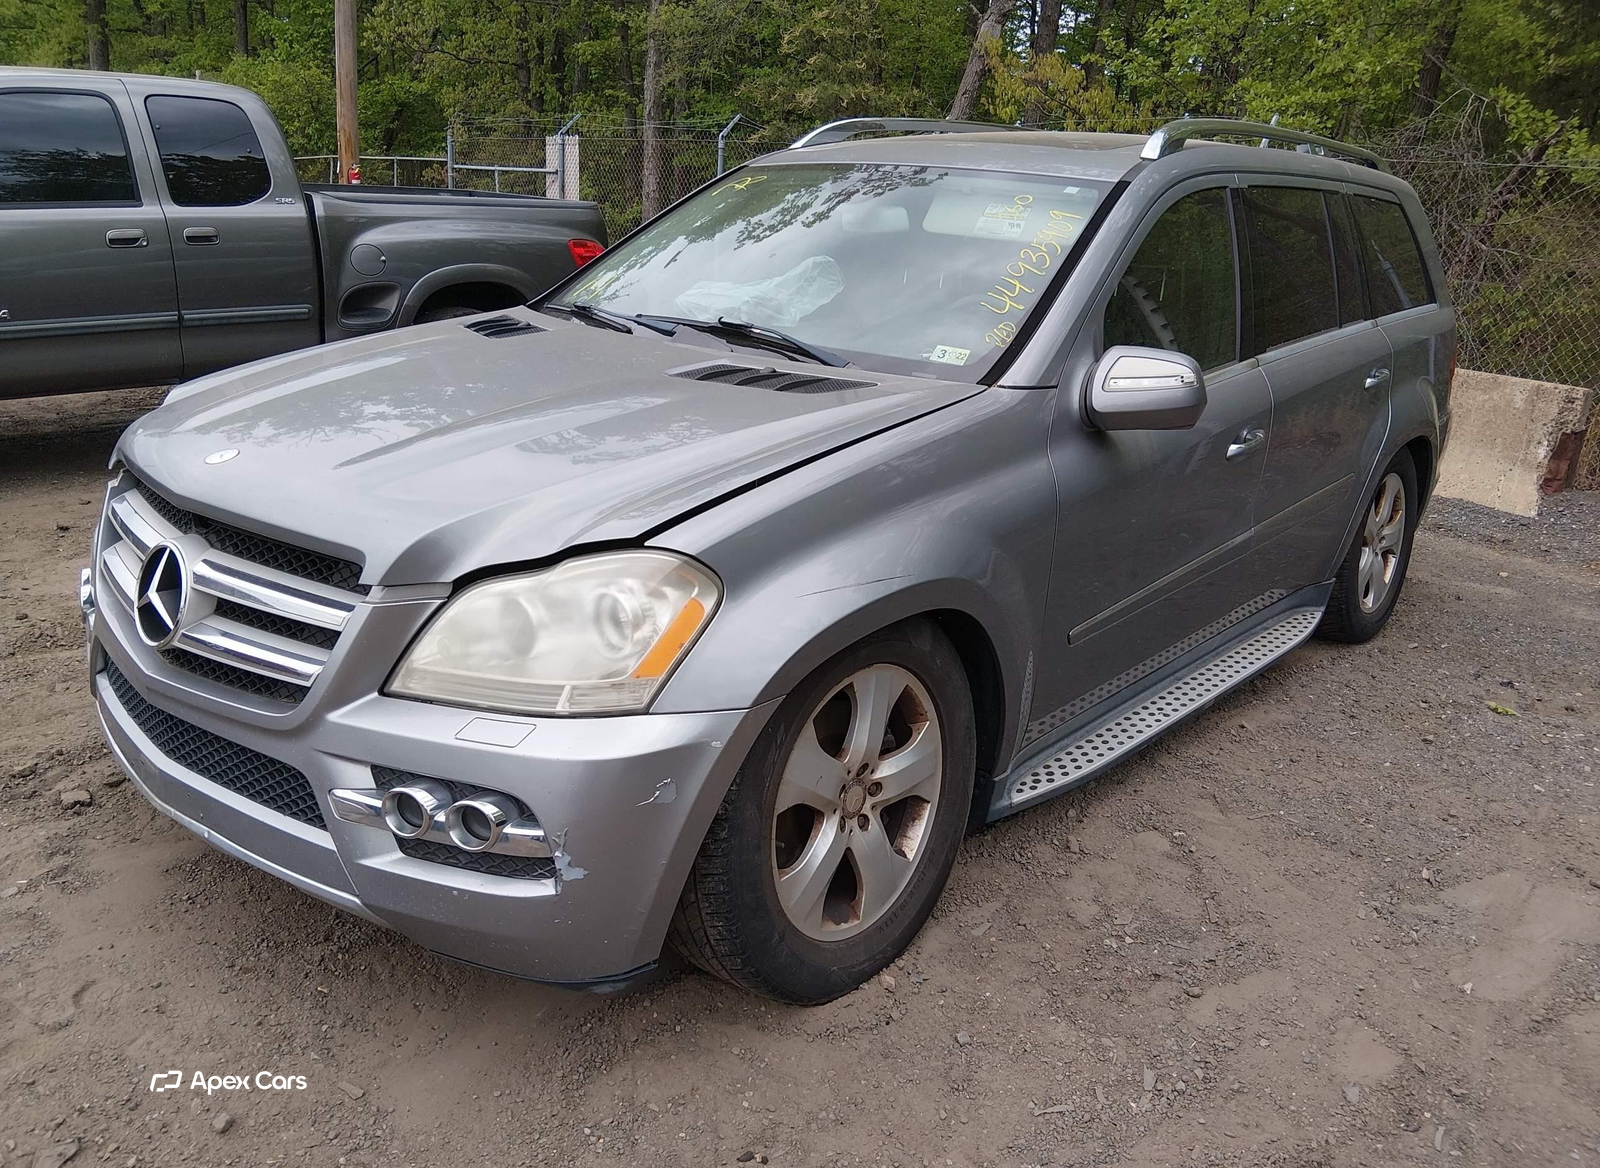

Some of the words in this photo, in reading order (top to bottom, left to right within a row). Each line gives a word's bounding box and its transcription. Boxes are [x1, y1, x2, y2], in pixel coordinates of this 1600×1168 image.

[979, 209, 1083, 315] 44935909
[937, 349, 947, 359] 3
[956, 352, 968, 360] 22
